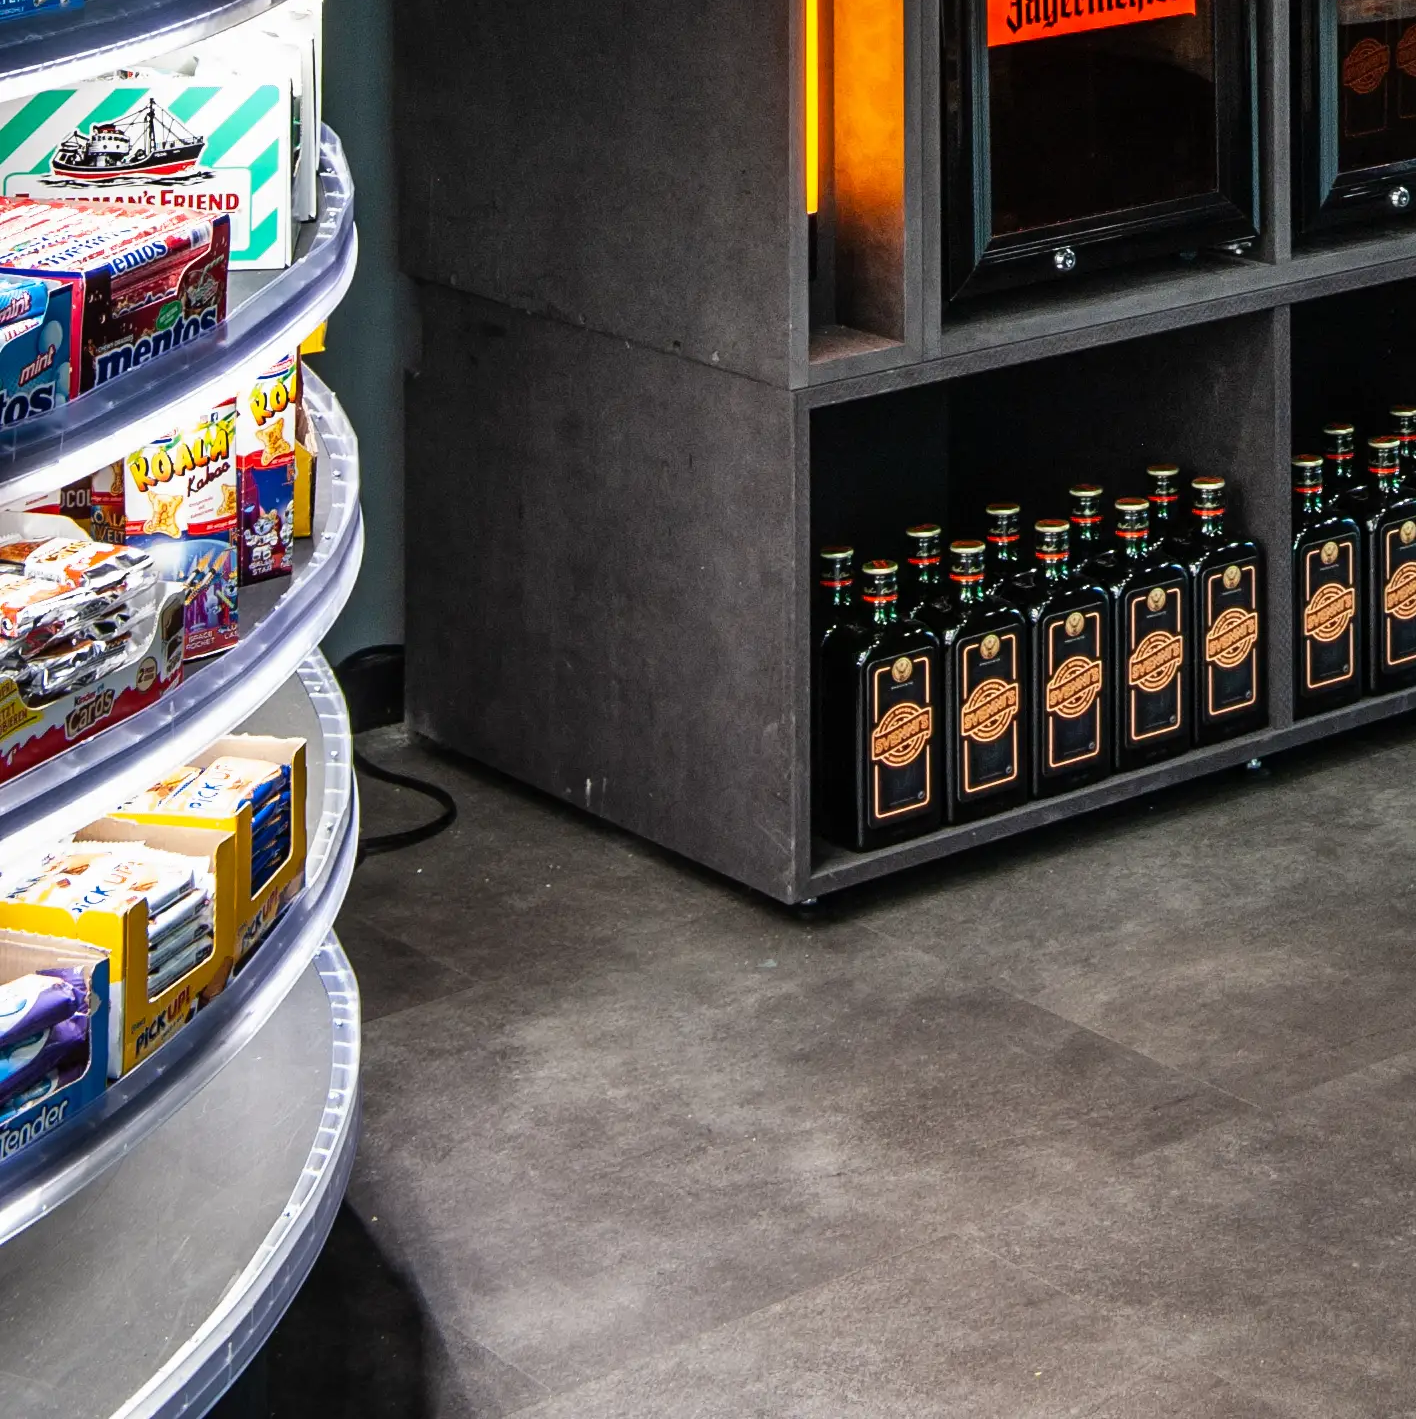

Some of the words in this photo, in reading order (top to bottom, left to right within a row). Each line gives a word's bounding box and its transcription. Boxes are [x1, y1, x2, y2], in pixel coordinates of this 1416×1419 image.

[160, 190, 240, 212] FRIEND
[19, 344, 55, 387] mint
[94, 304, 218, 390] mentos
[130, 428, 229, 492] KOALA
[187, 461, 231, 497] Kakao
[69, 689, 115, 734] Cards
[167, 984, 191, 1021] UP!
[0, 1099, 68, 1160] Tender
